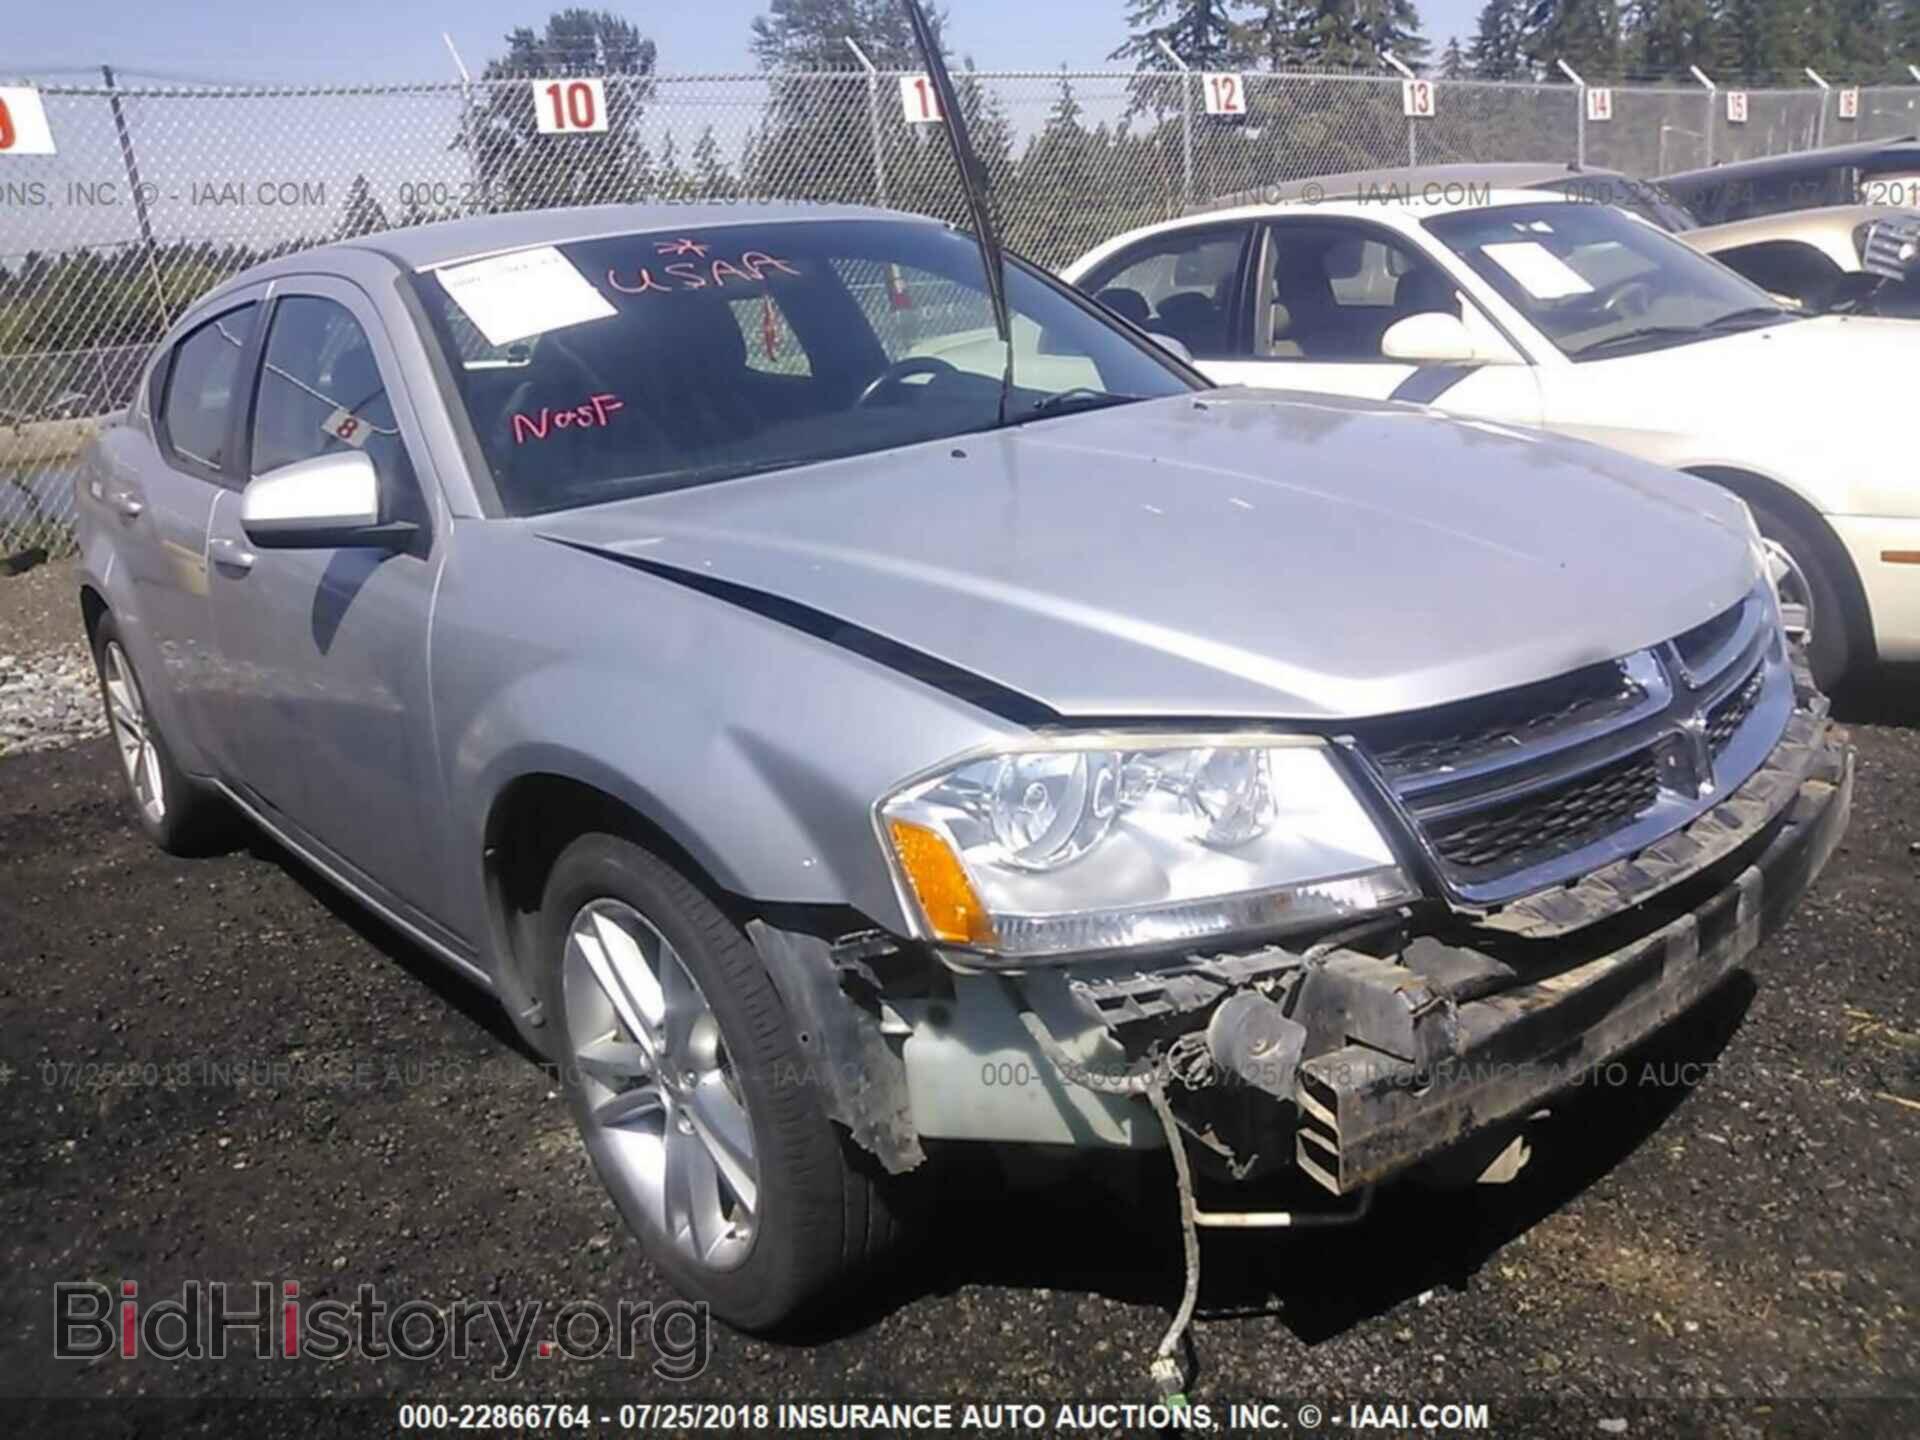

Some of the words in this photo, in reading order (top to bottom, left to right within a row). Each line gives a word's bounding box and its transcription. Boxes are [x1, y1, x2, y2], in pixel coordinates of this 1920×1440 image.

[546, 82, 596, 129] 10
[1211, 77, 1238, 111] 12
[1410, 83, 1429, 113] 13
[1592, 91, 1607, 115] 14
[1731, 94, 1744, 118] 15
[607, 251, 801, 293] USAA
[336, 418, 358, 439] 8
